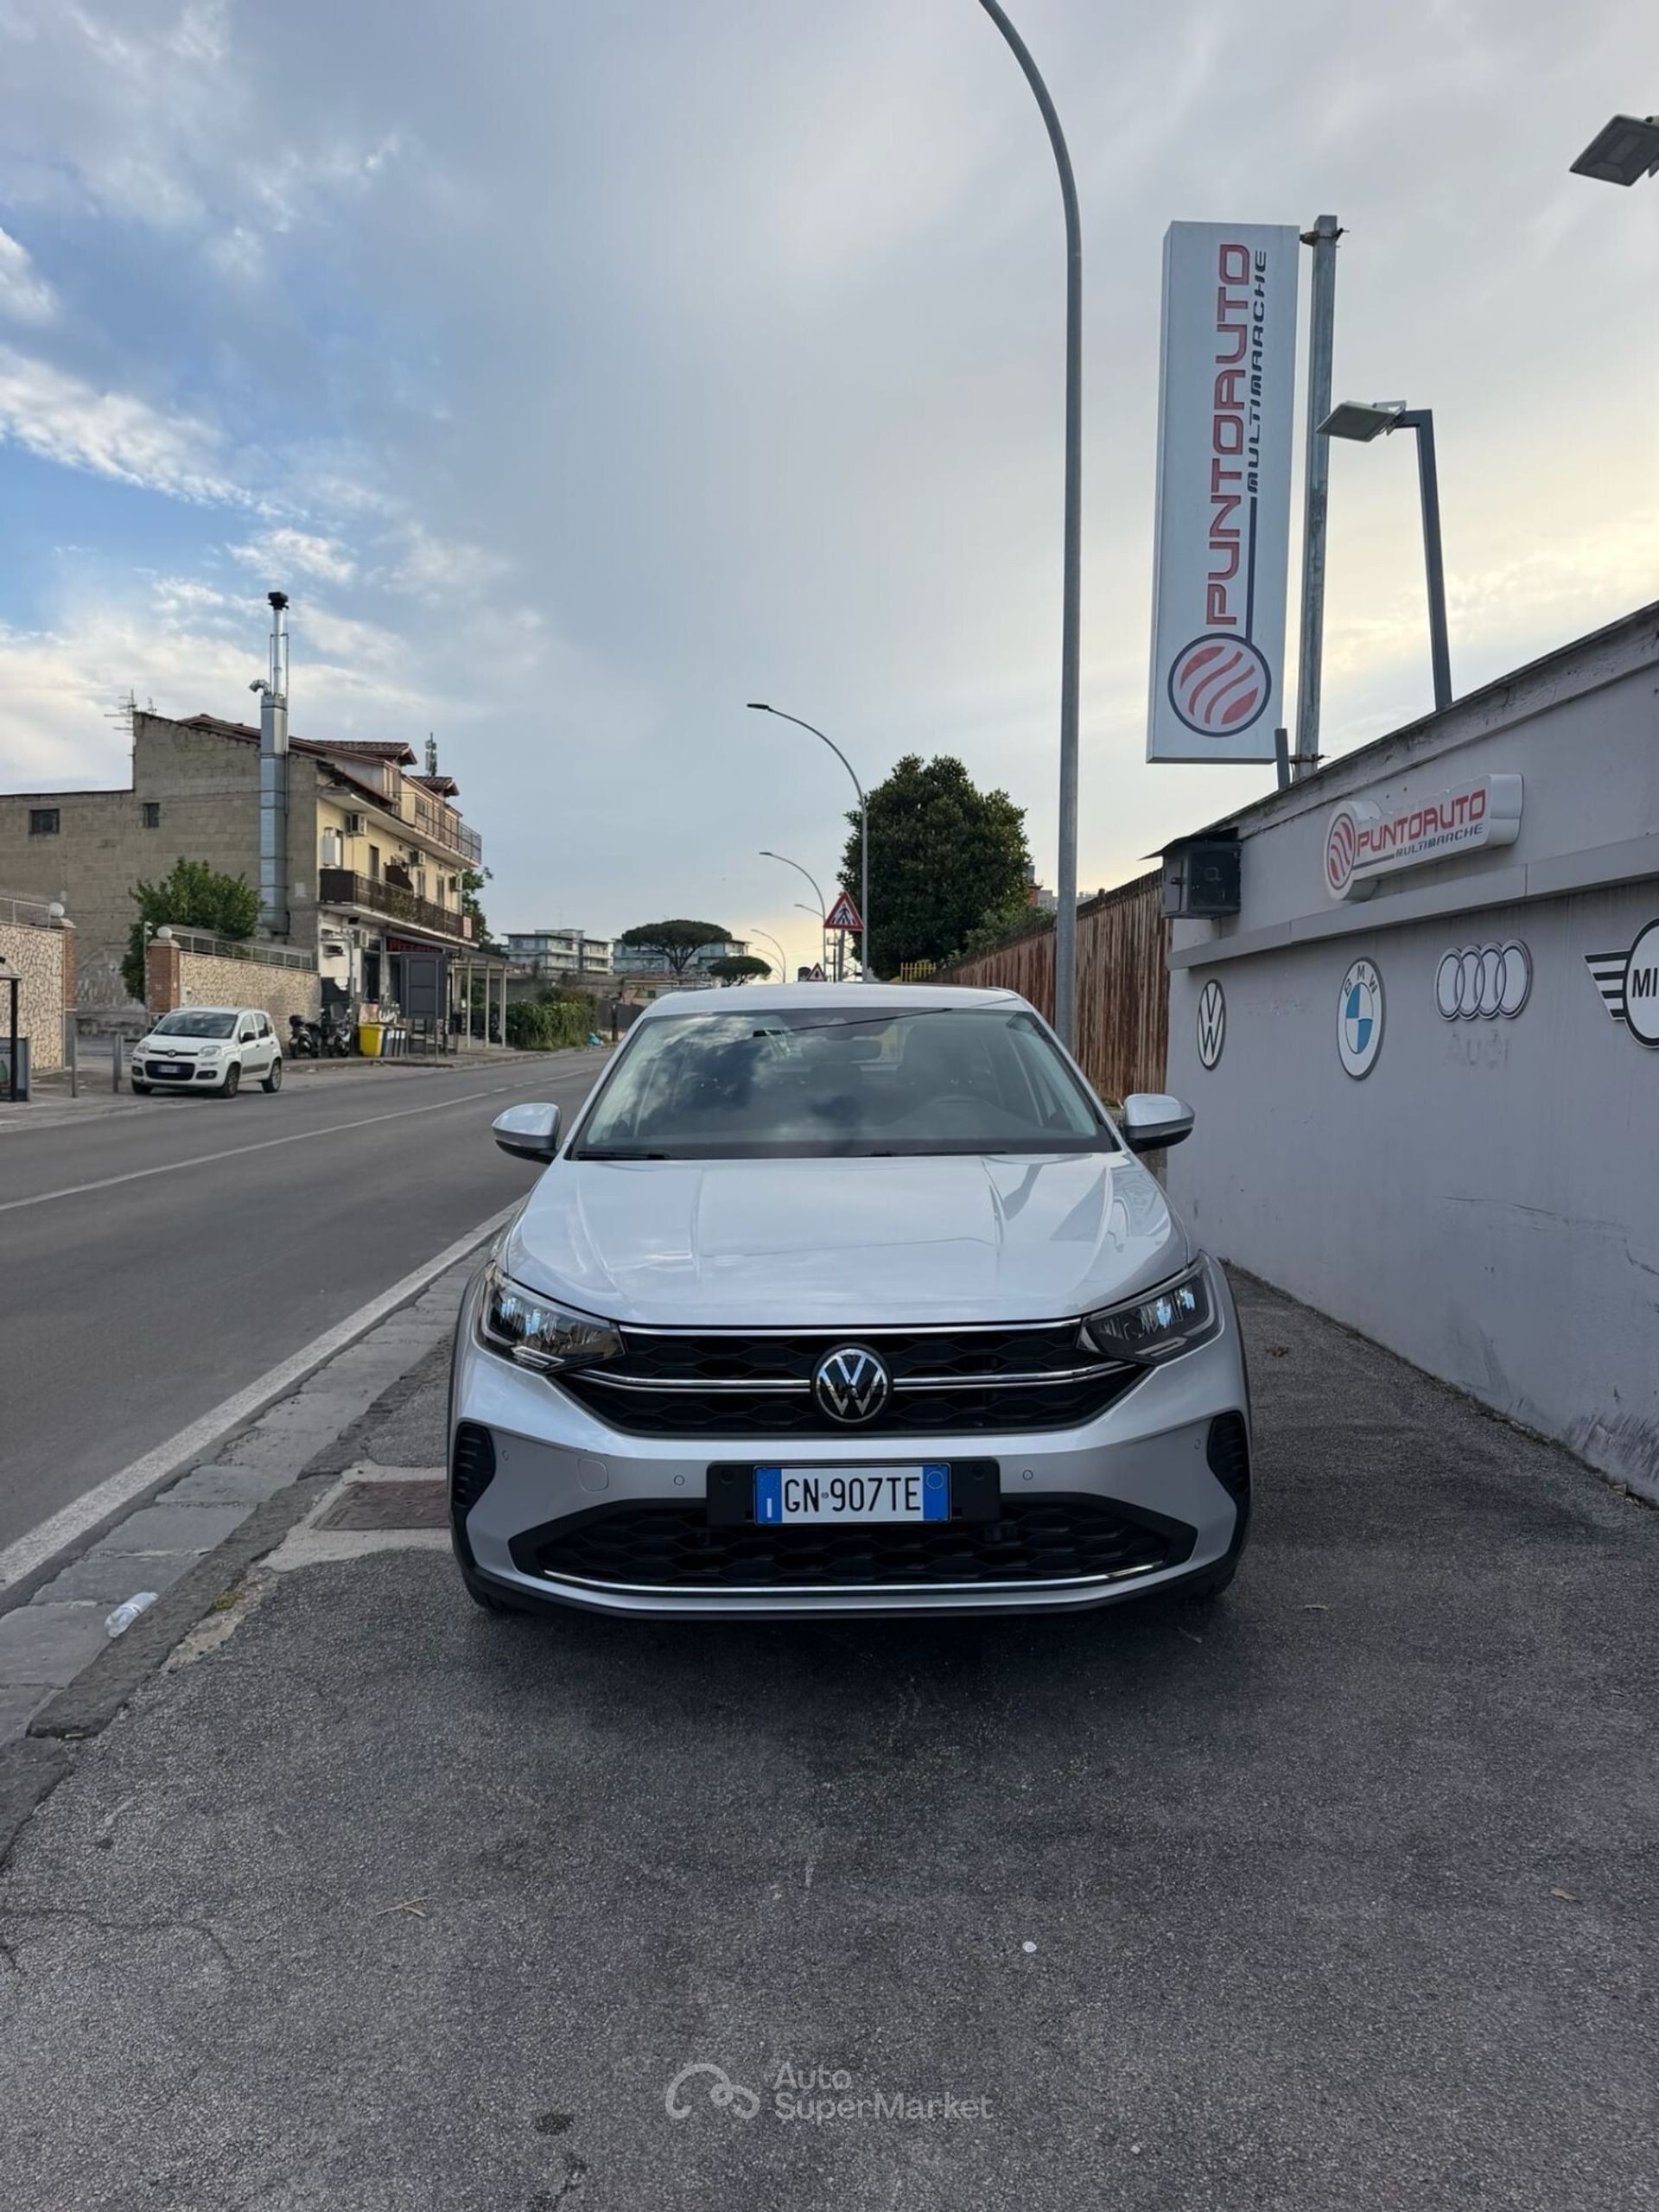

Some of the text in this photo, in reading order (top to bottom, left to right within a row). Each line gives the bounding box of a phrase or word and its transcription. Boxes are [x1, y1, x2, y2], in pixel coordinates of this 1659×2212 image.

[1247, 249, 1268, 493] MULTIMARCHE
[1206, 244, 1250, 625] PUNTOAUTO
[1357, 789, 1486, 857] PUNTOAUTO
[1395, 823, 1484, 858] MULTIMARCHE
[1344, 964, 1378, 997] BMW
